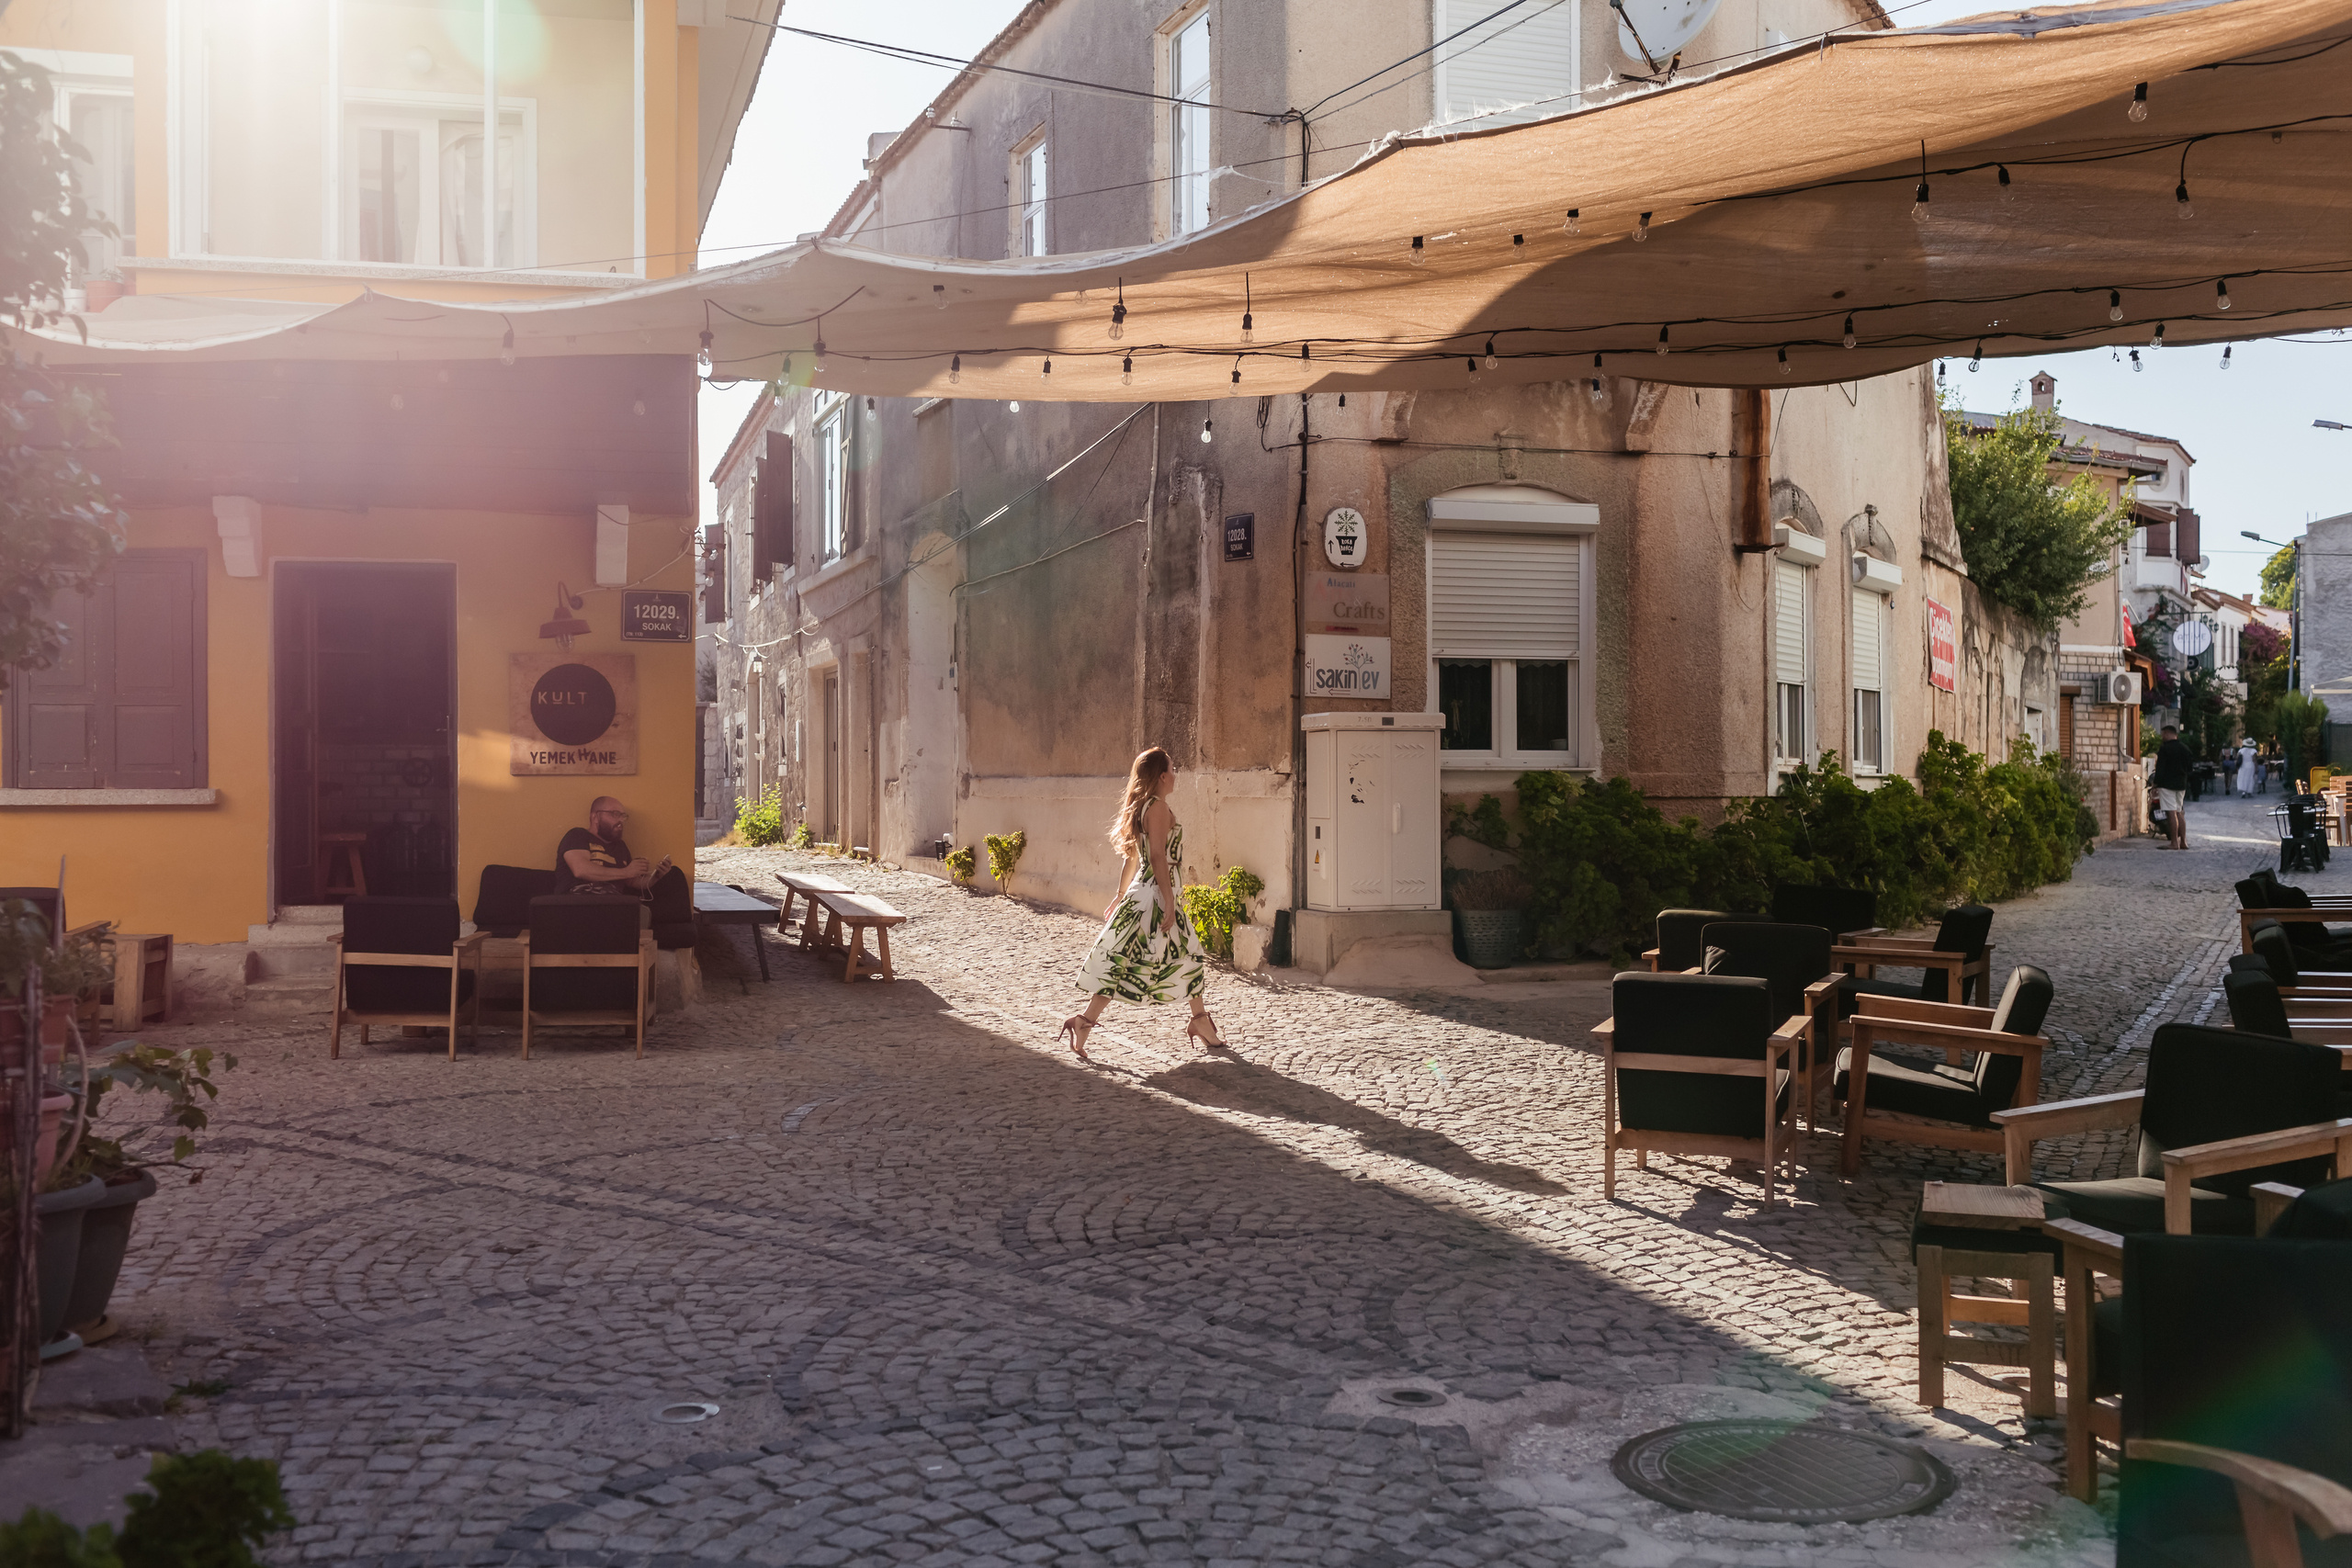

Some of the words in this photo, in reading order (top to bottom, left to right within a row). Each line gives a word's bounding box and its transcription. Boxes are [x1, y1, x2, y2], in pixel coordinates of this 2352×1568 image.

[1227, 527, 1247, 542] 12028.
[1230, 543, 1243, 551] SOKAK
[634, 604, 680, 620] 12029.
[1332, 601, 1385, 621] Crafts
[642, 622, 672, 632] SOKAK
[1316, 669, 1358, 690] sakin
[1362, 671, 1380, 691] ev
[537, 691, 588, 705] KULT
[530, 747, 616, 765] YEMEKHANE
